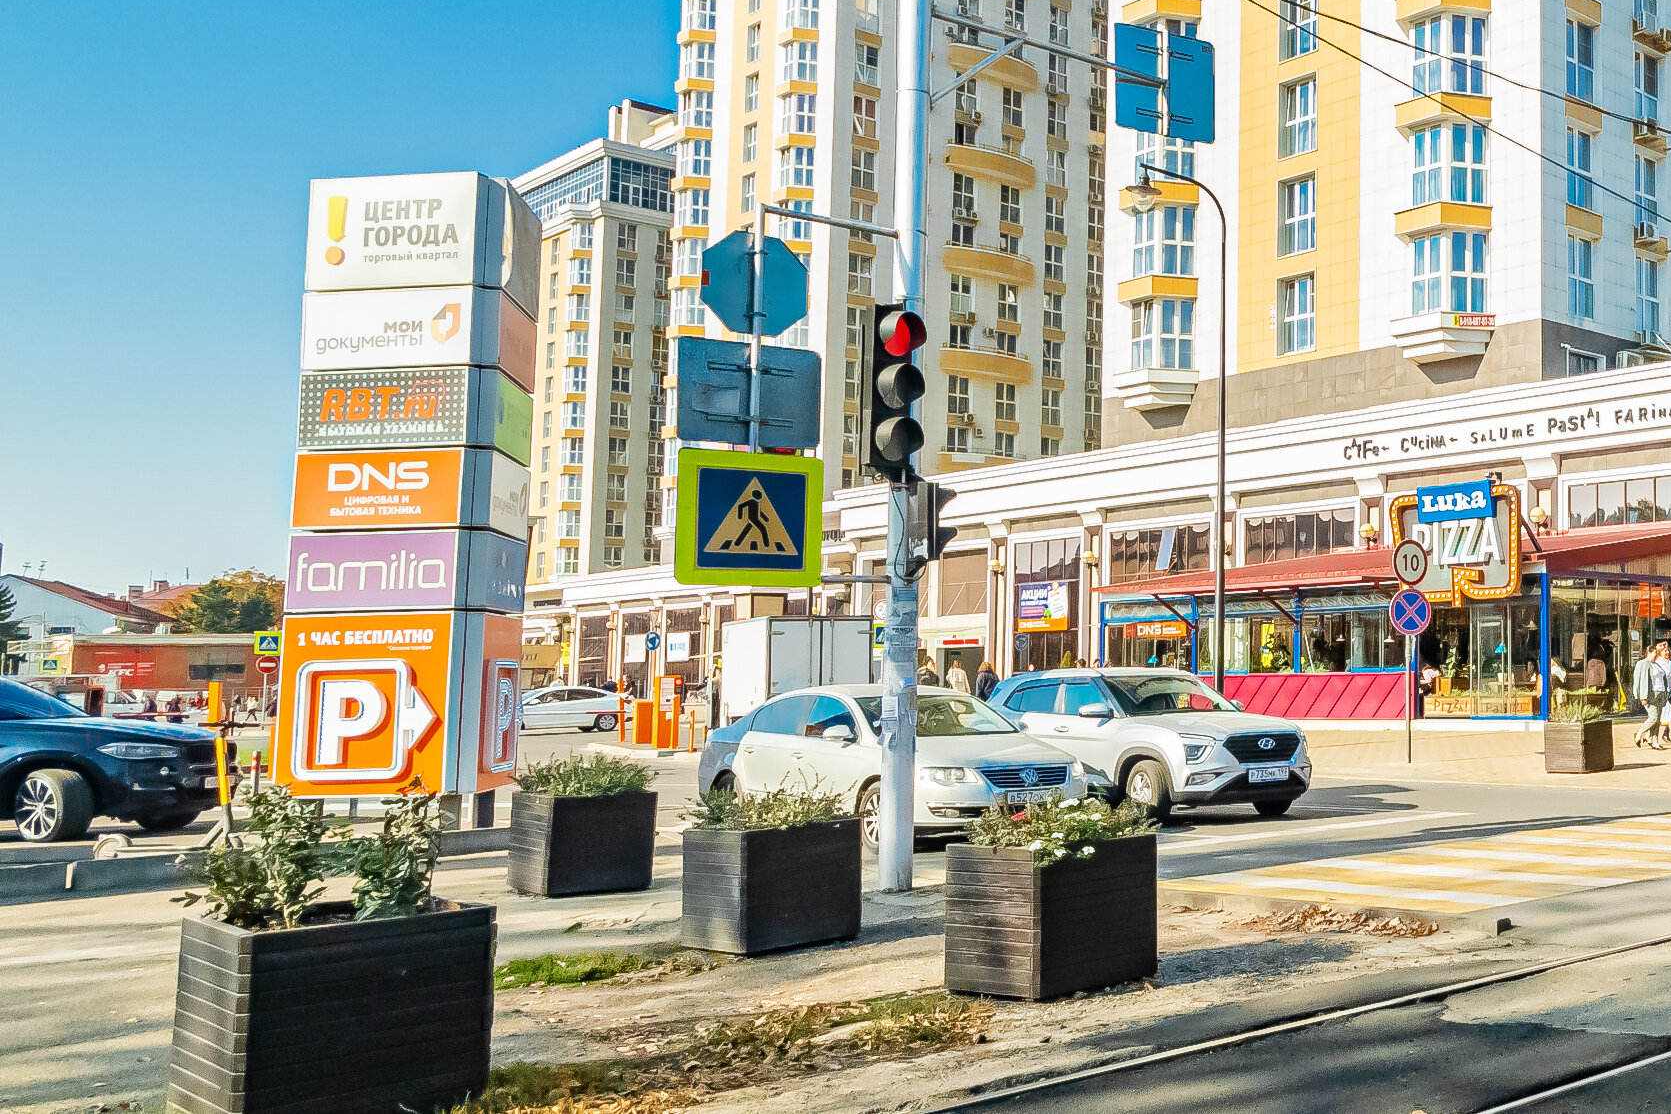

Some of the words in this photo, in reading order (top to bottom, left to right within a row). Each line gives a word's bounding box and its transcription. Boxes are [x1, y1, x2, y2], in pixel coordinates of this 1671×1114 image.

[364, 198, 442, 223] ЦЕНТР
[363, 224, 459, 247] ГОРОДА
[363, 251, 413, 264] торговый
[416, 249, 459, 262] квартал
[383, 320, 423, 334] мои
[316, 334, 423, 354] документы
[319, 387, 437, 423] RBT.ru
[327, 460, 430, 492] DNS
[344, 495, 399, 506] ЦИФРОВАЯ
[402, 495, 409, 503] И
[1421, 490, 1486, 513] Luka
[330, 507, 376, 517] БЫТОВАЯ
[378, 505, 422, 515] ТЕХНИКА
[1411, 517, 1500, 566] PIZZA
[295, 549, 447, 593] familia
[1402, 554, 1420, 572] 10
[298, 632, 306, 646] 1
[311, 630, 342, 646] ЧАС
[344, 628, 435, 646] БЕСПЛАТНО
[1137, 624, 1161, 636] DNS
